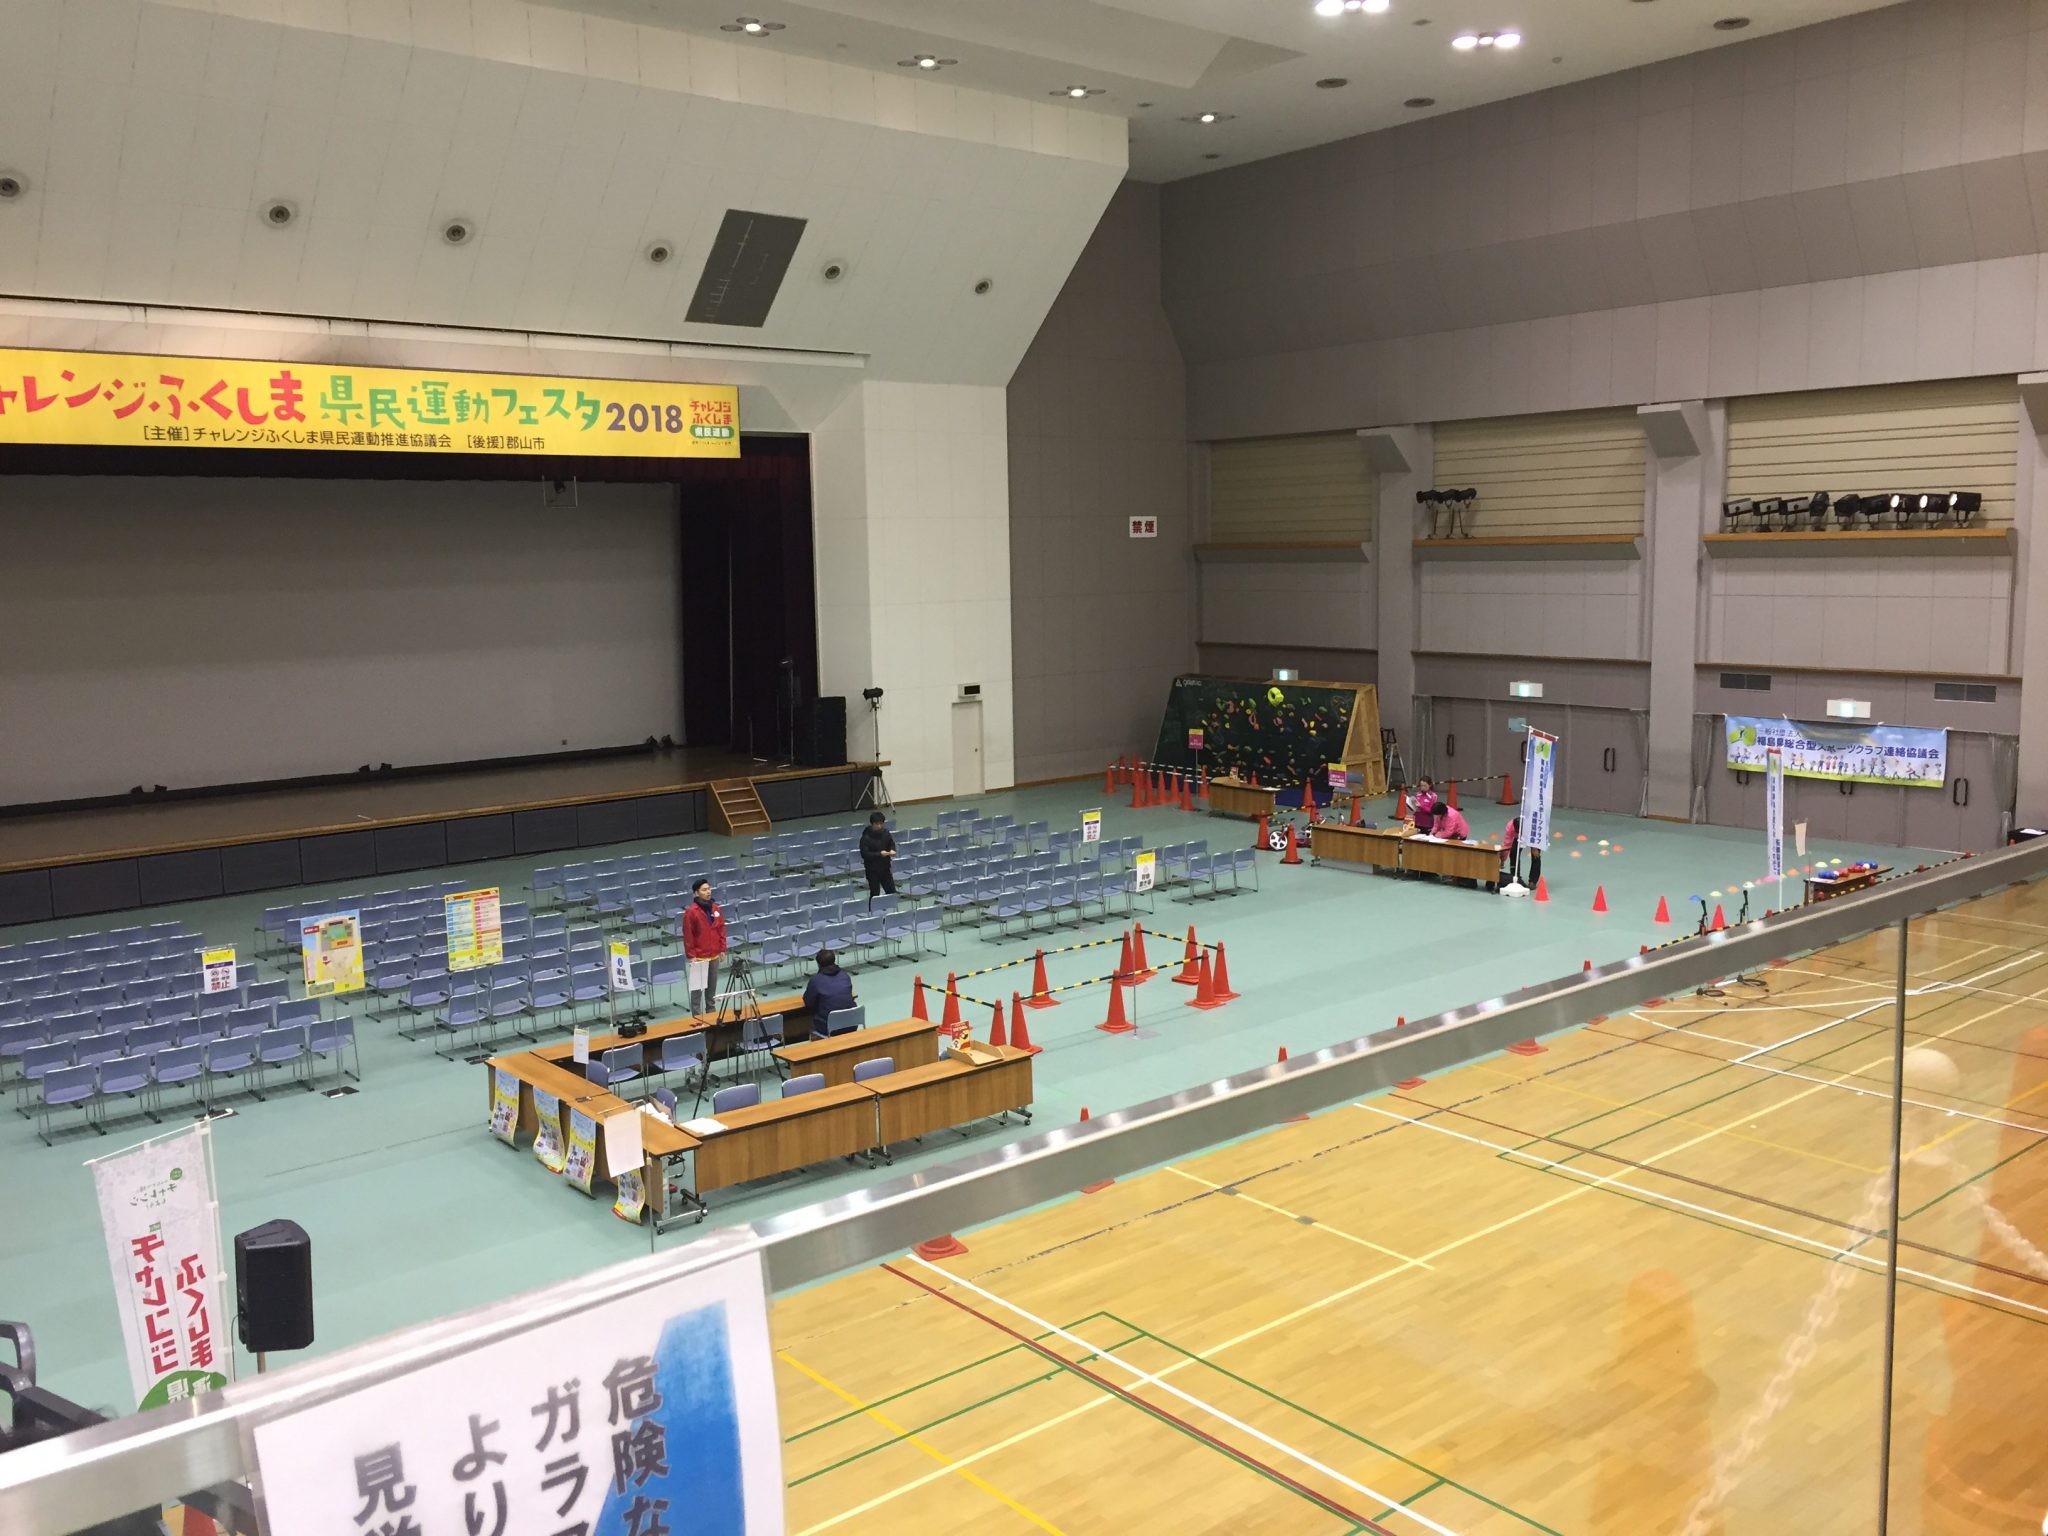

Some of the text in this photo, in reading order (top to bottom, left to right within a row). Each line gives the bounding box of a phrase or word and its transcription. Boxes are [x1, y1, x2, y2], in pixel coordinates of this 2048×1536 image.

[689, 400, 732, 412] チャレンジ
[692, 413, 733, 425] ふくしま
[1132, 520, 1155, 534] 禁煙
[602, 1355, 672, 1536] 危険な
